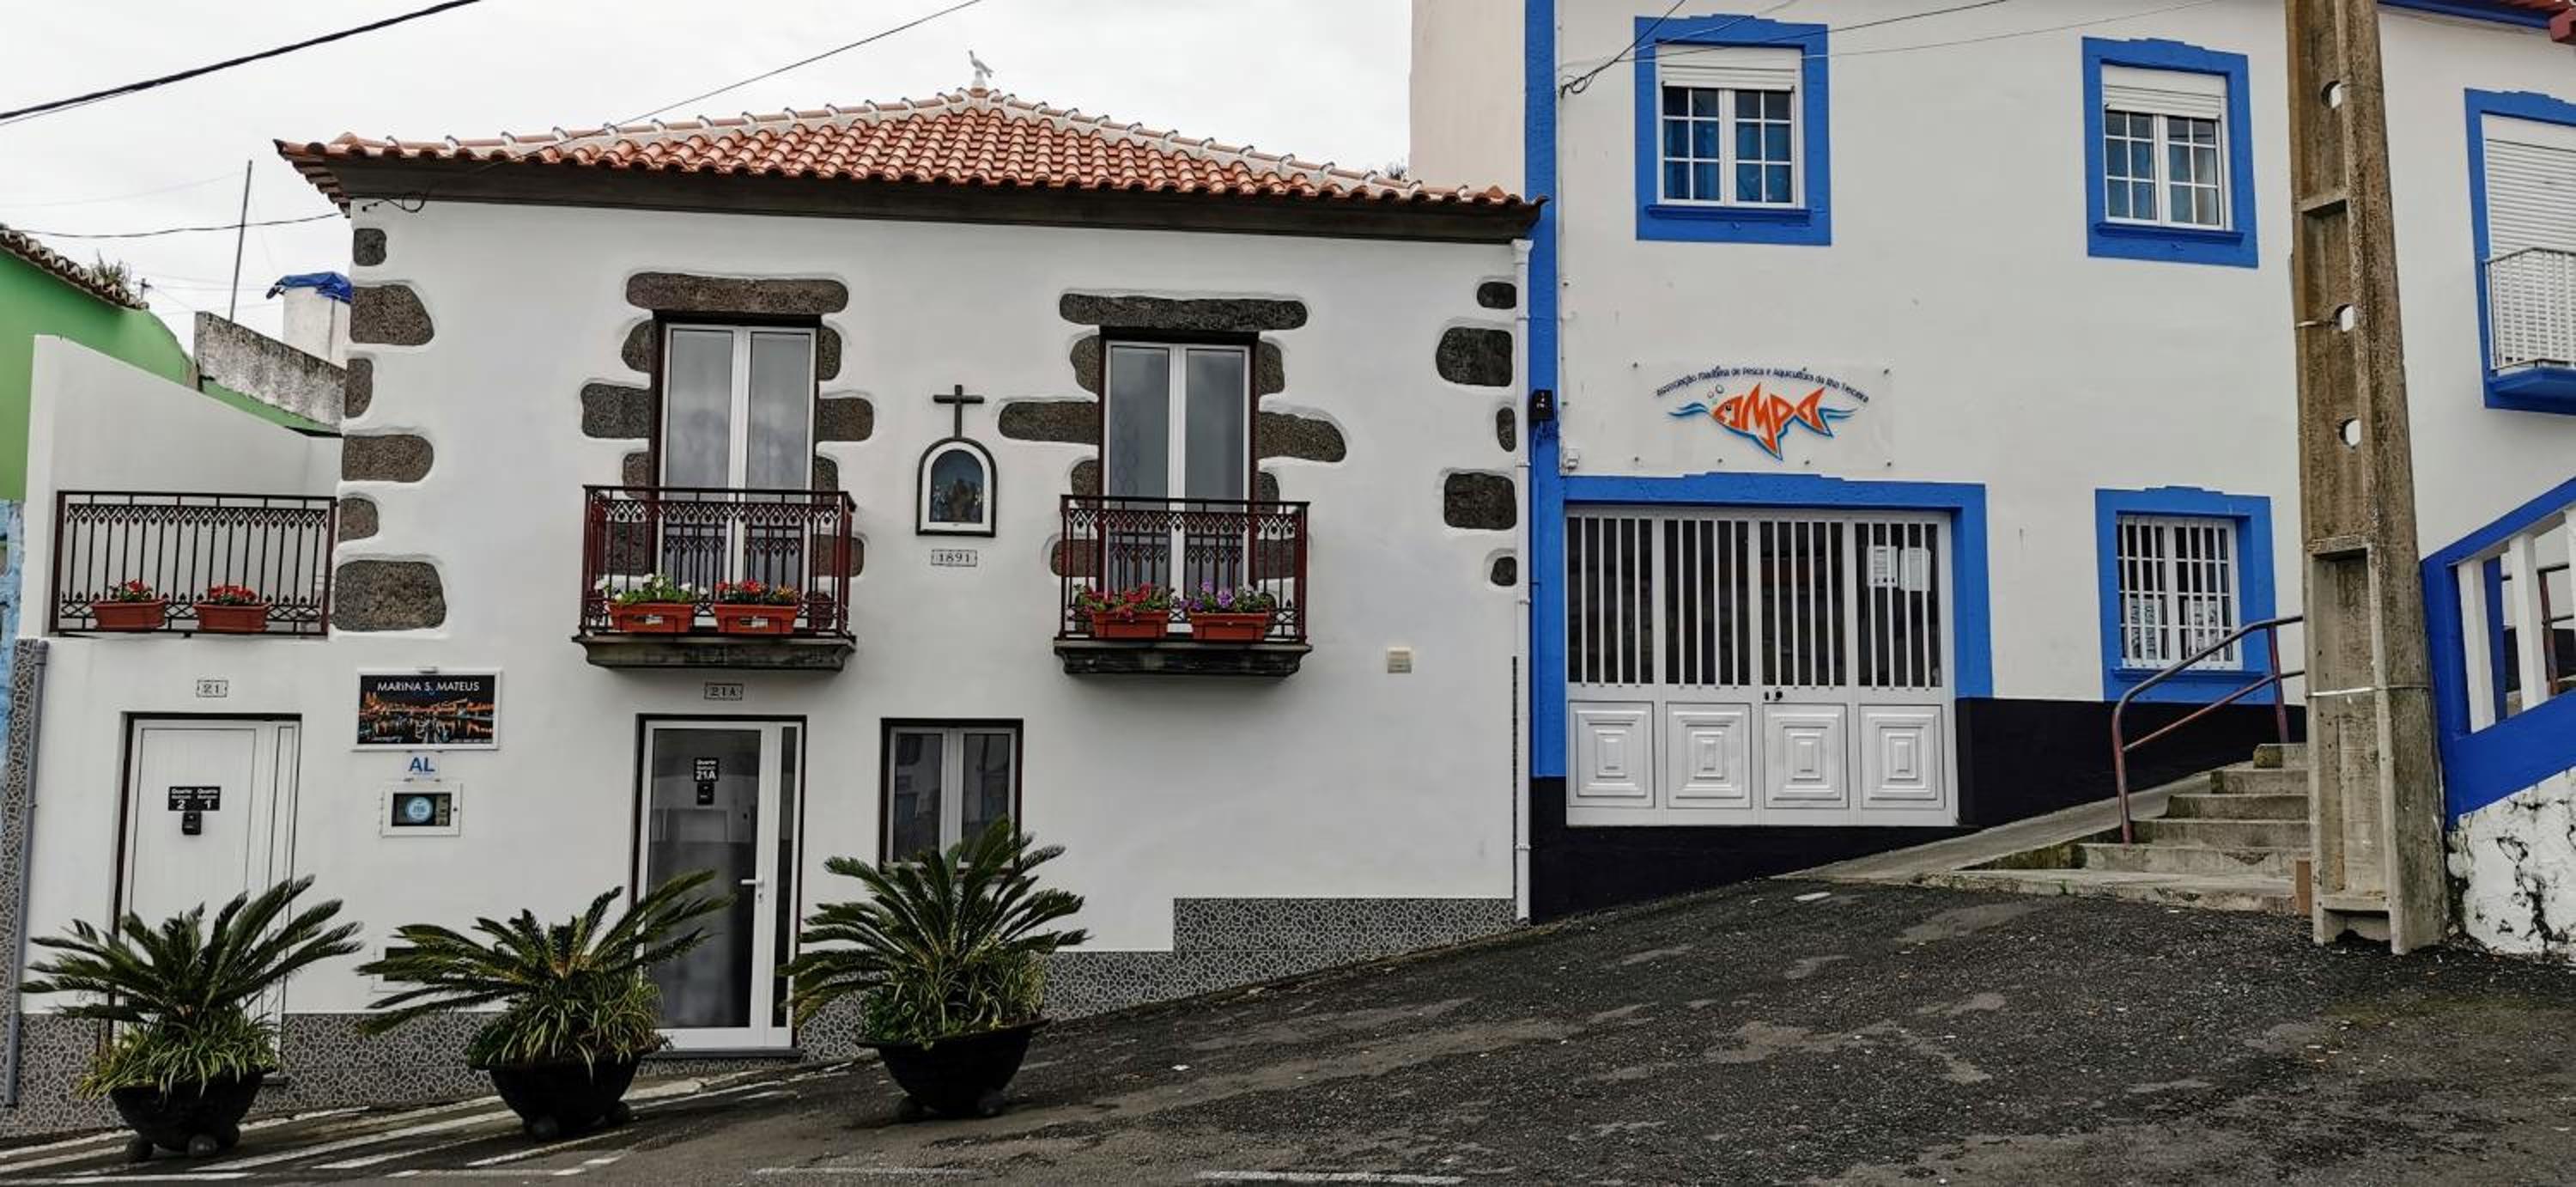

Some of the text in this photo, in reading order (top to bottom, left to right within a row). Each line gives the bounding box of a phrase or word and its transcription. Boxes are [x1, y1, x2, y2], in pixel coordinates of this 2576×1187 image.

[939, 552, 969, 563] 1891
[203, 684, 220, 694] 21
[377, 681, 480, 692] MARINA S. MATEUS
[710, 687, 737, 697] 21A
[408, 757, 435, 772] AL
[696, 770, 717, 781] 21A
[177, 800, 185, 810] 2
[204, 800, 212, 810] 1
